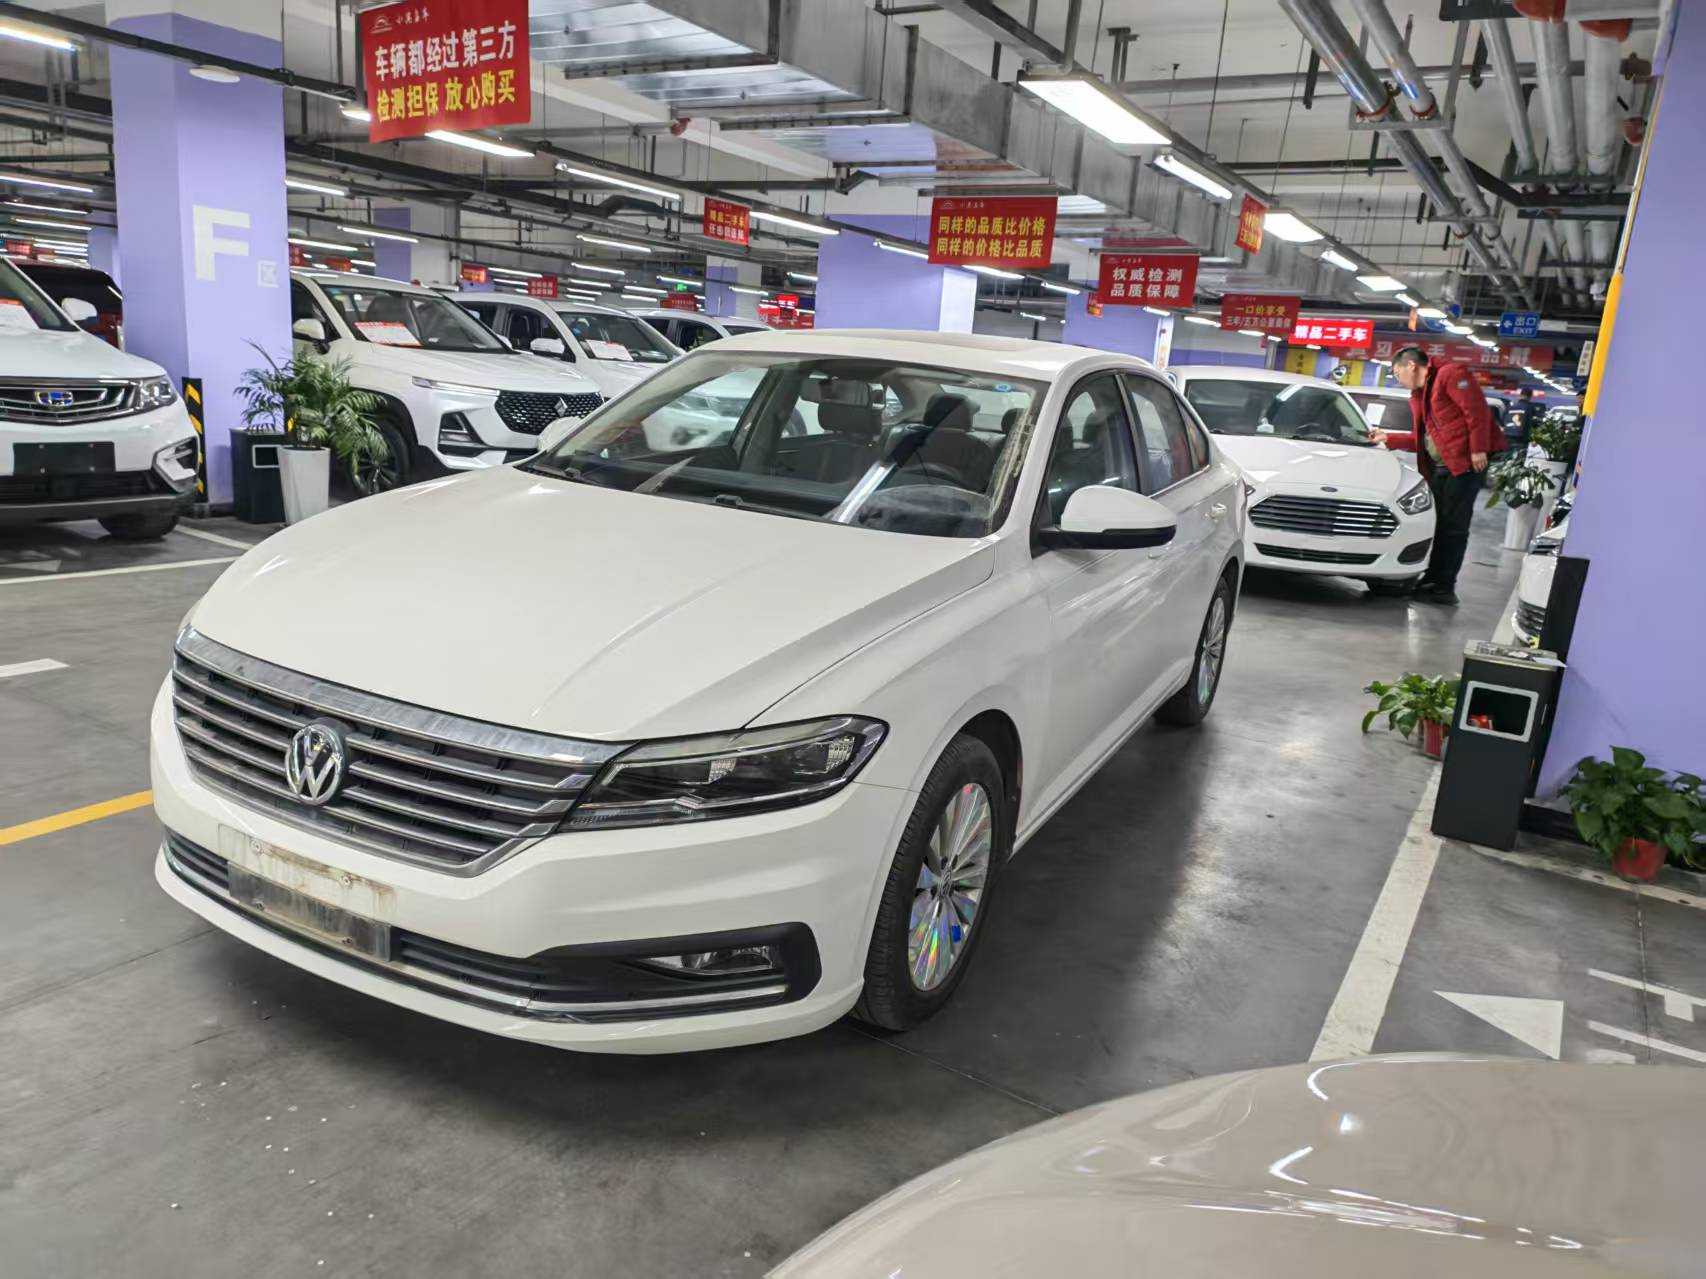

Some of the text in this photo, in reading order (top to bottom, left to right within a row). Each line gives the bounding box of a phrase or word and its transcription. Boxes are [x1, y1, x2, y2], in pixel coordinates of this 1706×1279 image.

[374, 20, 517, 82] 车辆都经过第三方
[377, 68, 516, 123] 检测担保 放心购买
[938, 216, 1046, 237] 同样的品质比价格
[193, 205, 250, 281] F
[936, 237, 1044, 259] 同样的价格比品质
[1112, 267, 1183, 283] 权威检测
[1110, 283, 1180, 299] 品质保障
[1295, 325, 1368, 342] 精品二手车
